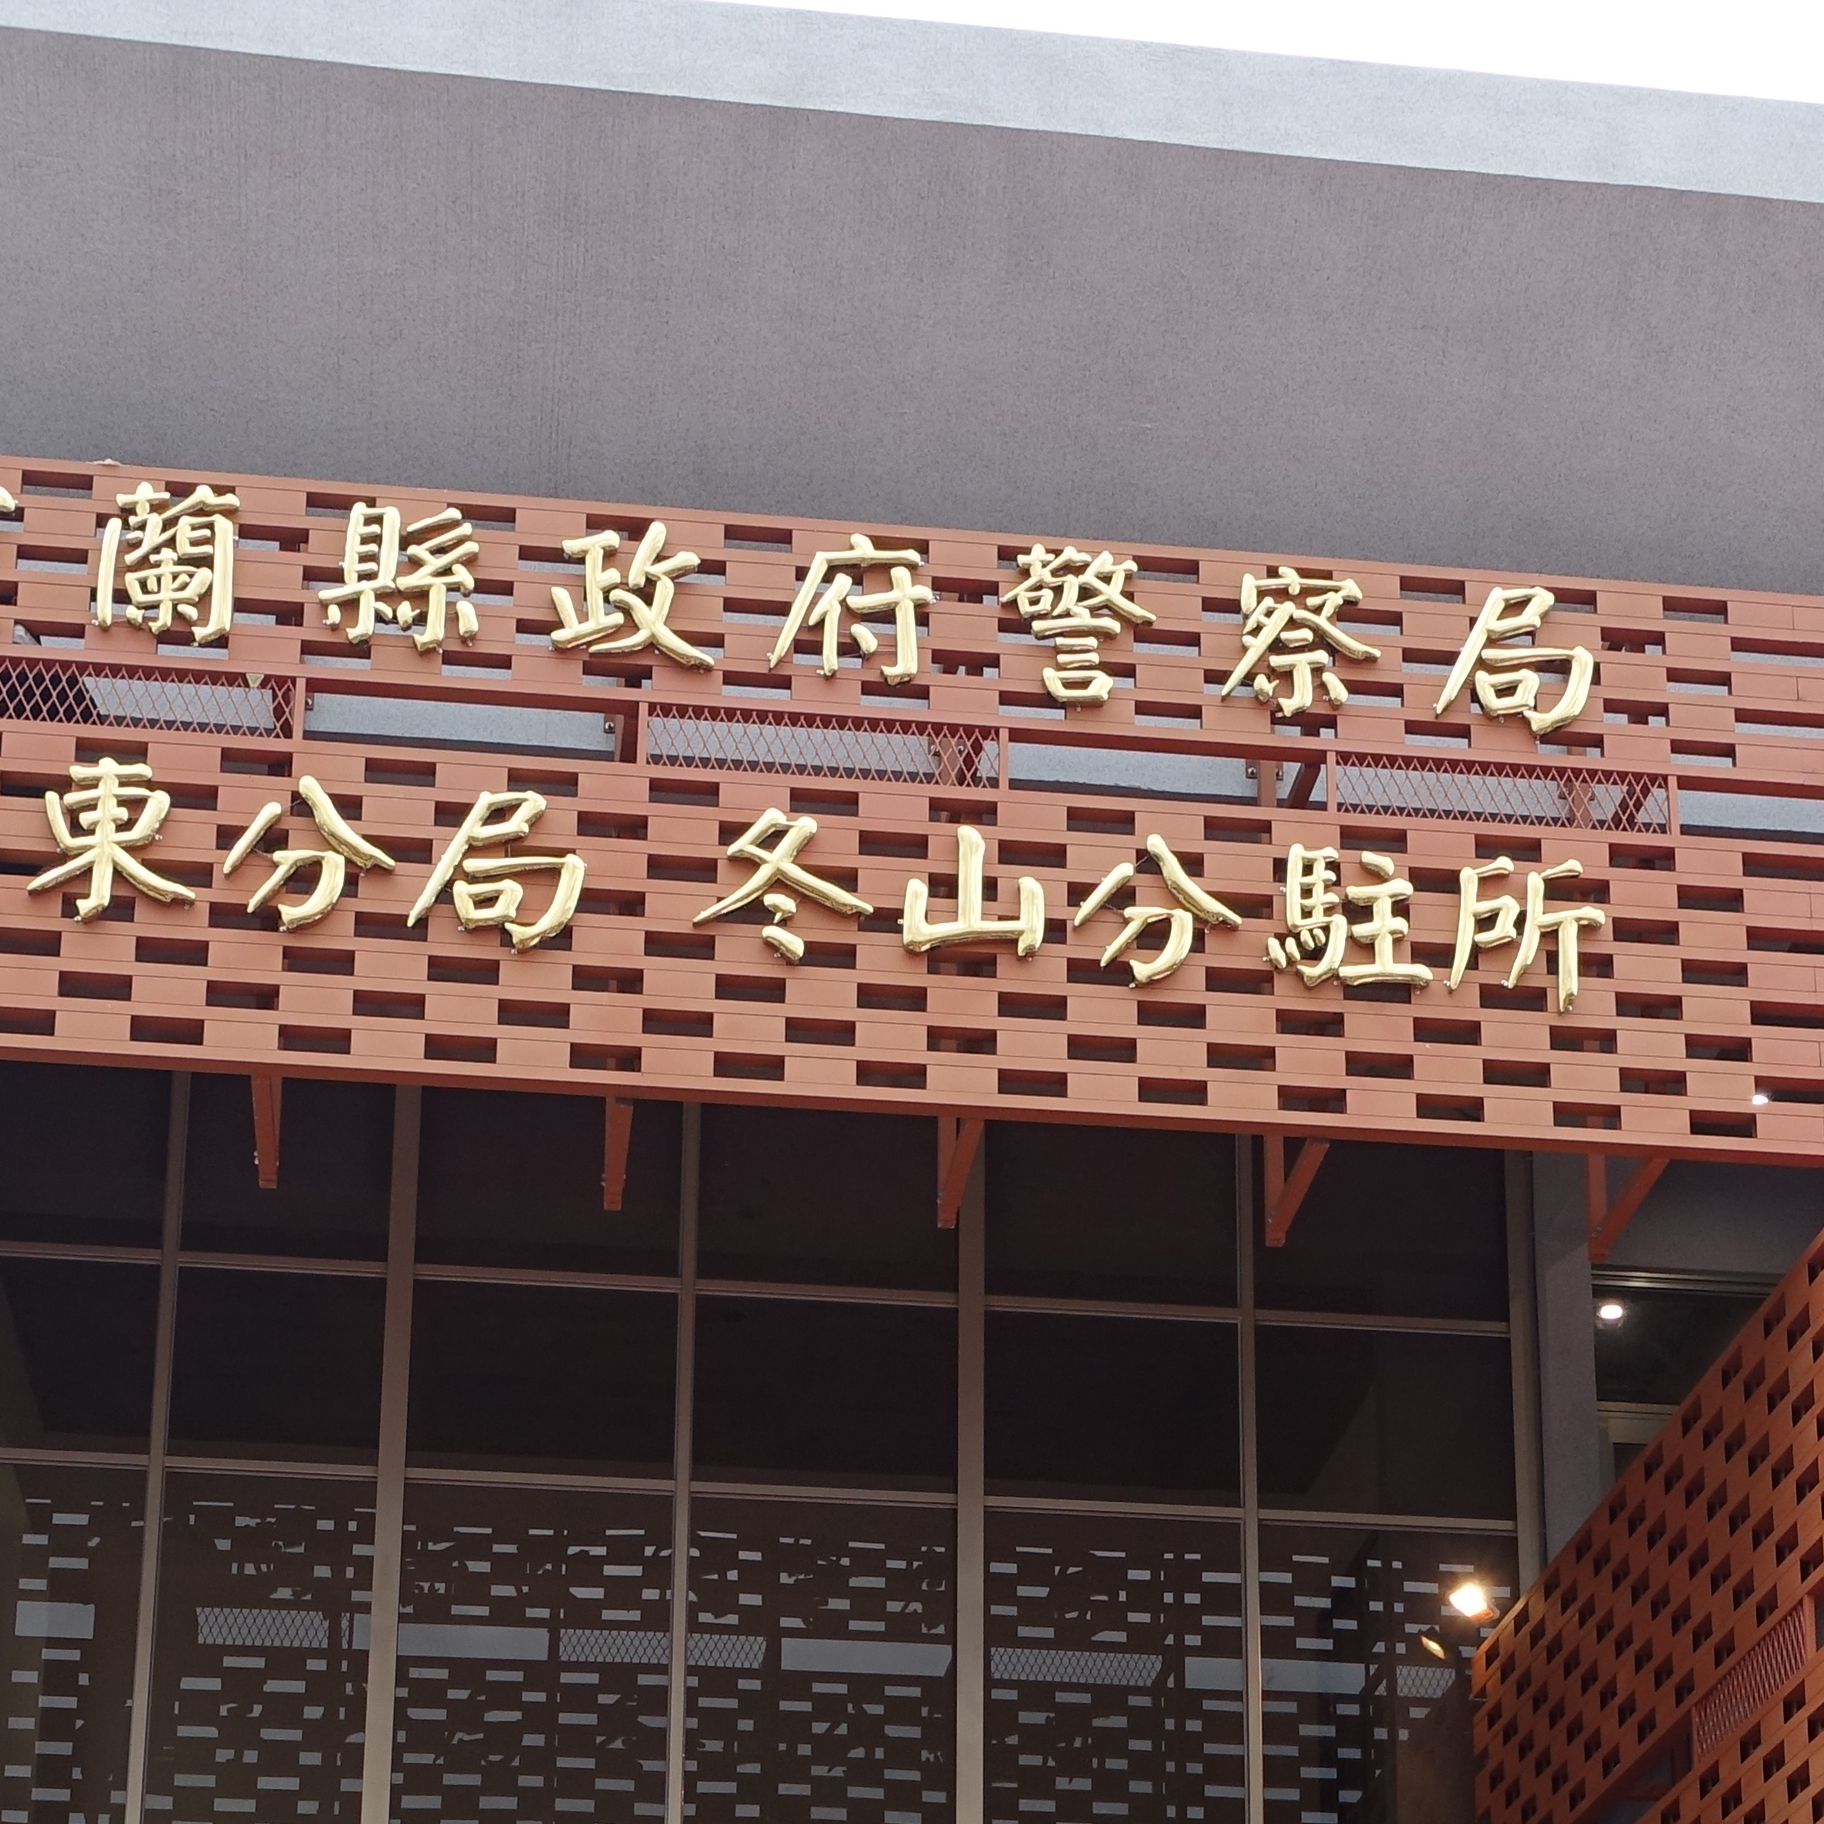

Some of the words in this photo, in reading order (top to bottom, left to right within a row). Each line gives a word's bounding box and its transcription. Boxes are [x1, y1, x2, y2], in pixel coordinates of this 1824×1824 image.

[694, 810, 1608, 1012] 冬山分駐所
